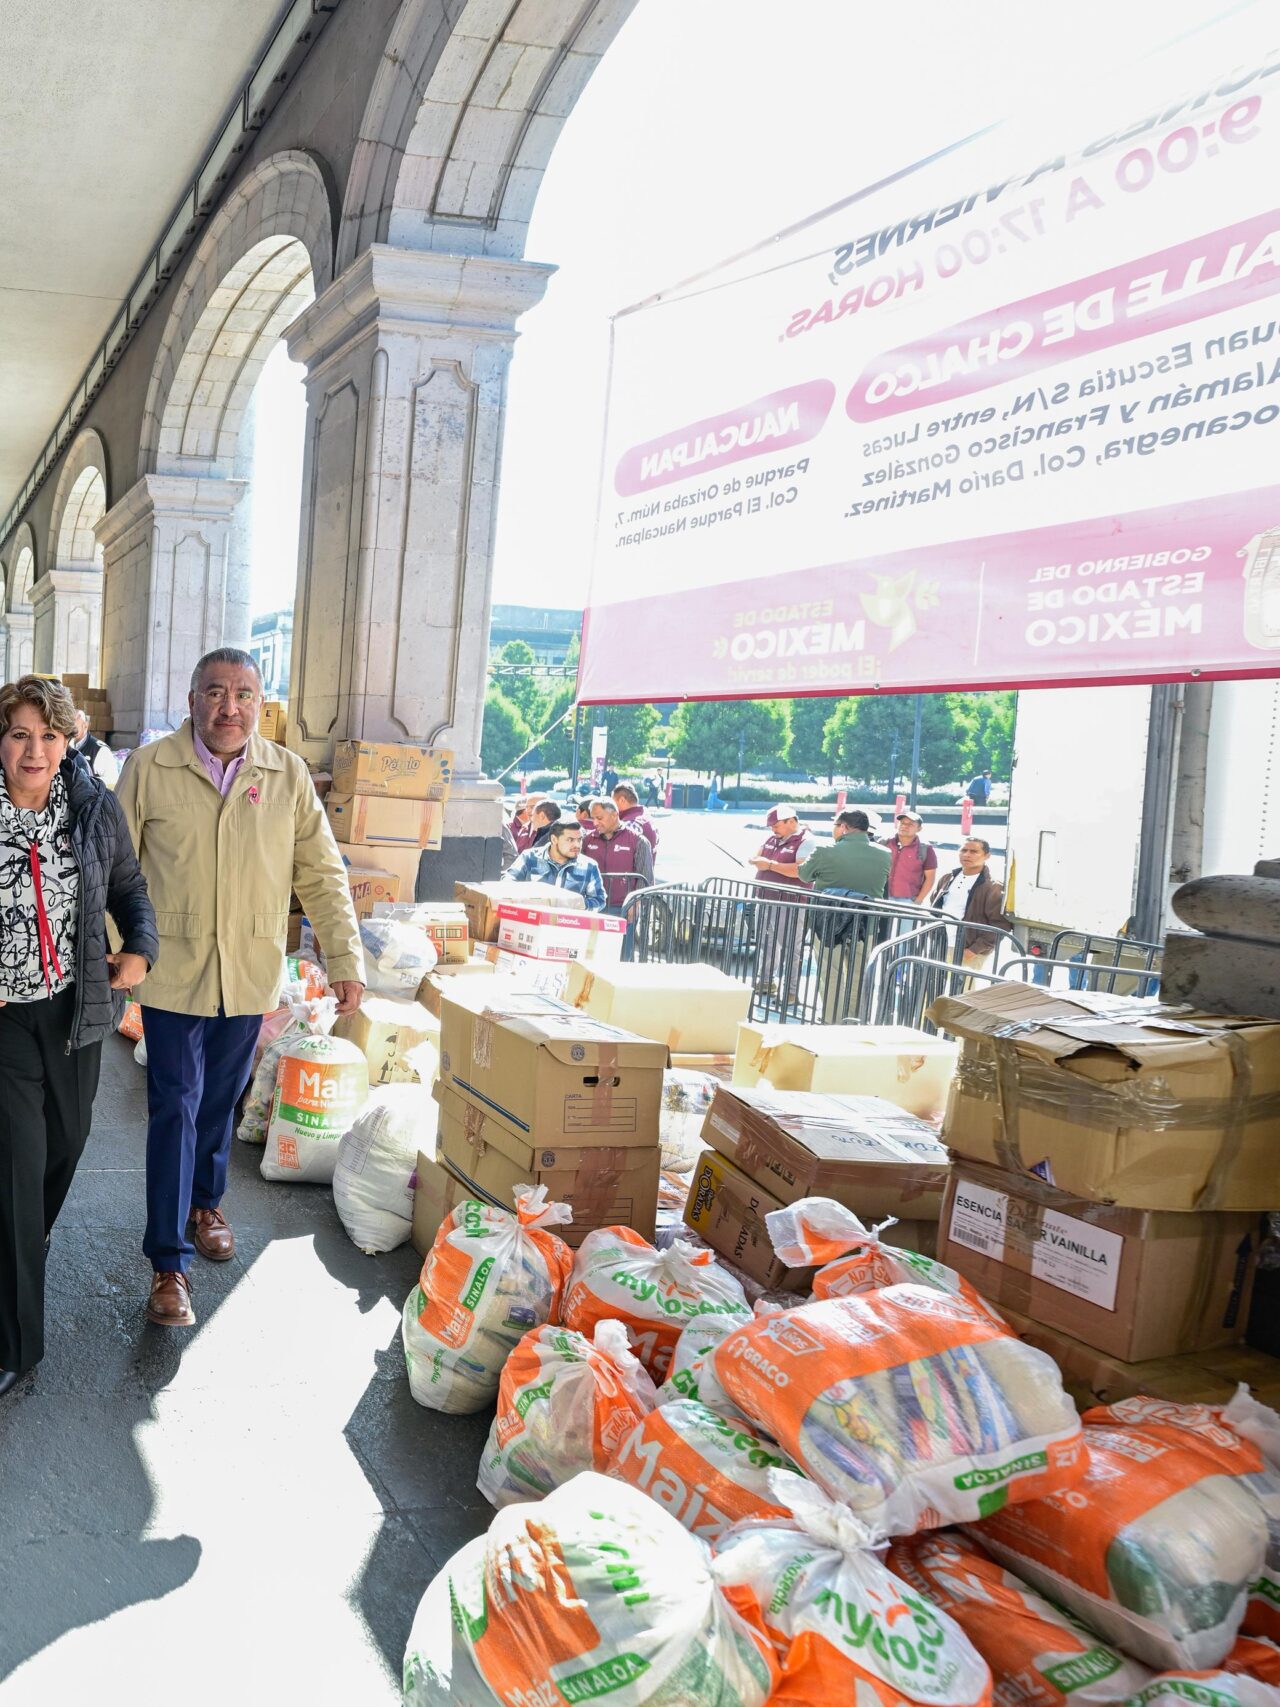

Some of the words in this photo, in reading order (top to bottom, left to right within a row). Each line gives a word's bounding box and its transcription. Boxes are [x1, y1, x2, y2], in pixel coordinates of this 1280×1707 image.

[380, 755, 421, 774] Péalo
[400, 971, 420, 987] PAS
[294, 1127, 316, 1139] Nuevo
[691, 1165, 713, 1222] DORADAS
[956, 1195, 1003, 1224] ESENCIA
[1050, 1233, 1109, 1266] VAINILLA
[466, 1261, 494, 1307] SINALOA
[560, 1657, 643, 1701] SINALOA
